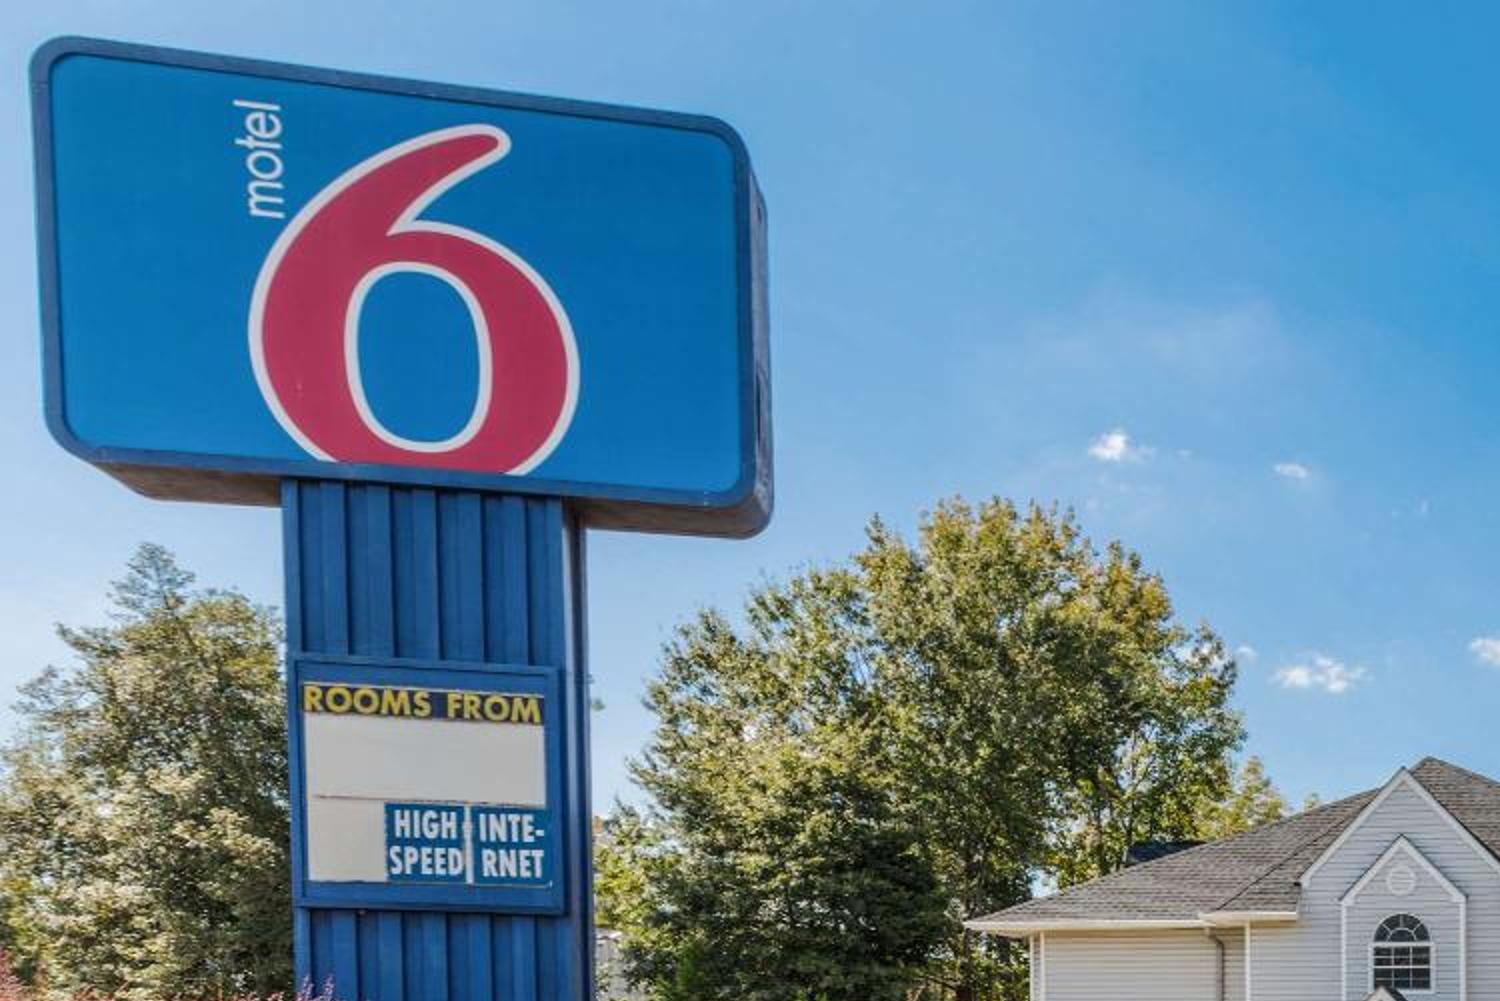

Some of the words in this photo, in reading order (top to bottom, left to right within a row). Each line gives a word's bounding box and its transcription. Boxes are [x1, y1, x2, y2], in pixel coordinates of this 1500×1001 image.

[232, 99, 286, 219] motel
[248, 123, 581, 477] 6
[303, 684, 431, 717] ROOMS
[447, 692, 542, 724] FROM
[394, 809, 458, 841] HIGH
[478, 813, 545, 843] INTE-
[389, 845, 464, 876] SPEED
[481, 849, 545, 878] RNET
